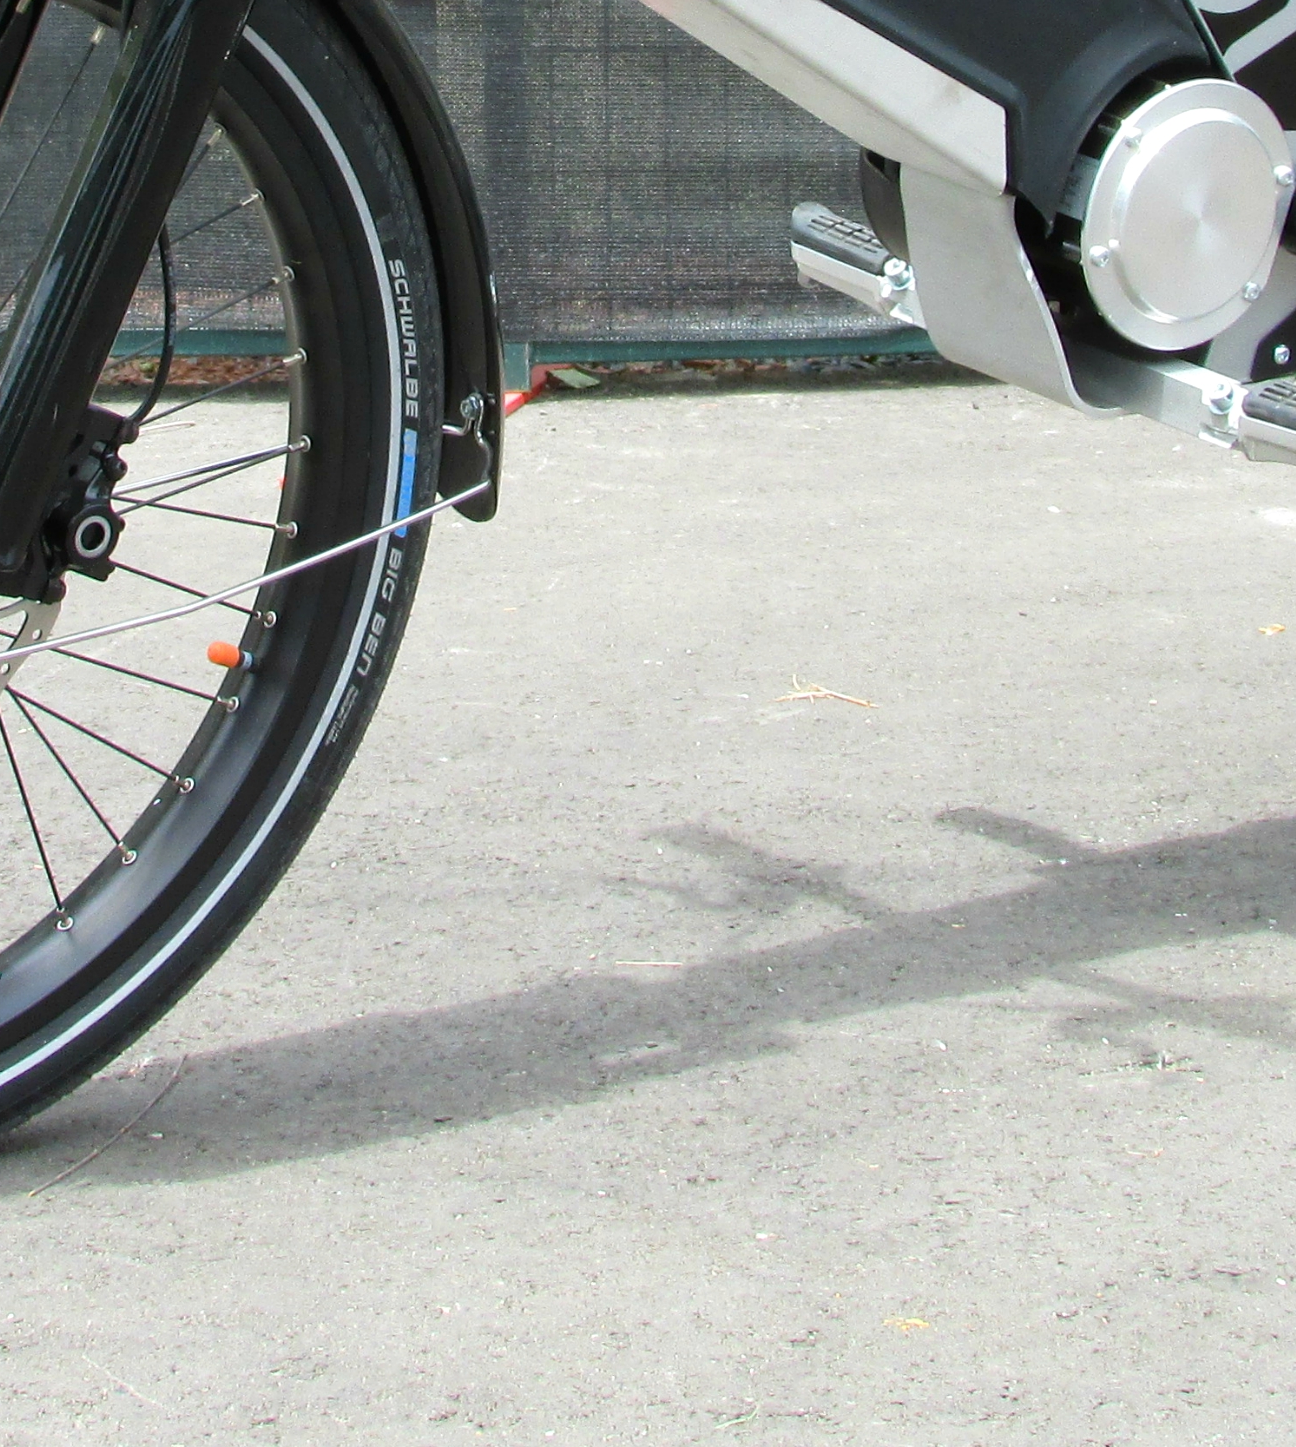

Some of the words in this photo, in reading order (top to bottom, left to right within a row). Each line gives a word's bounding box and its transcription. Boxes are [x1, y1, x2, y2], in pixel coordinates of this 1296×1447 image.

[388, 258, 419, 418] SCHWALBE
[381, 547, 403, 603] BIG
[356, 611, 387, 677] BEN
